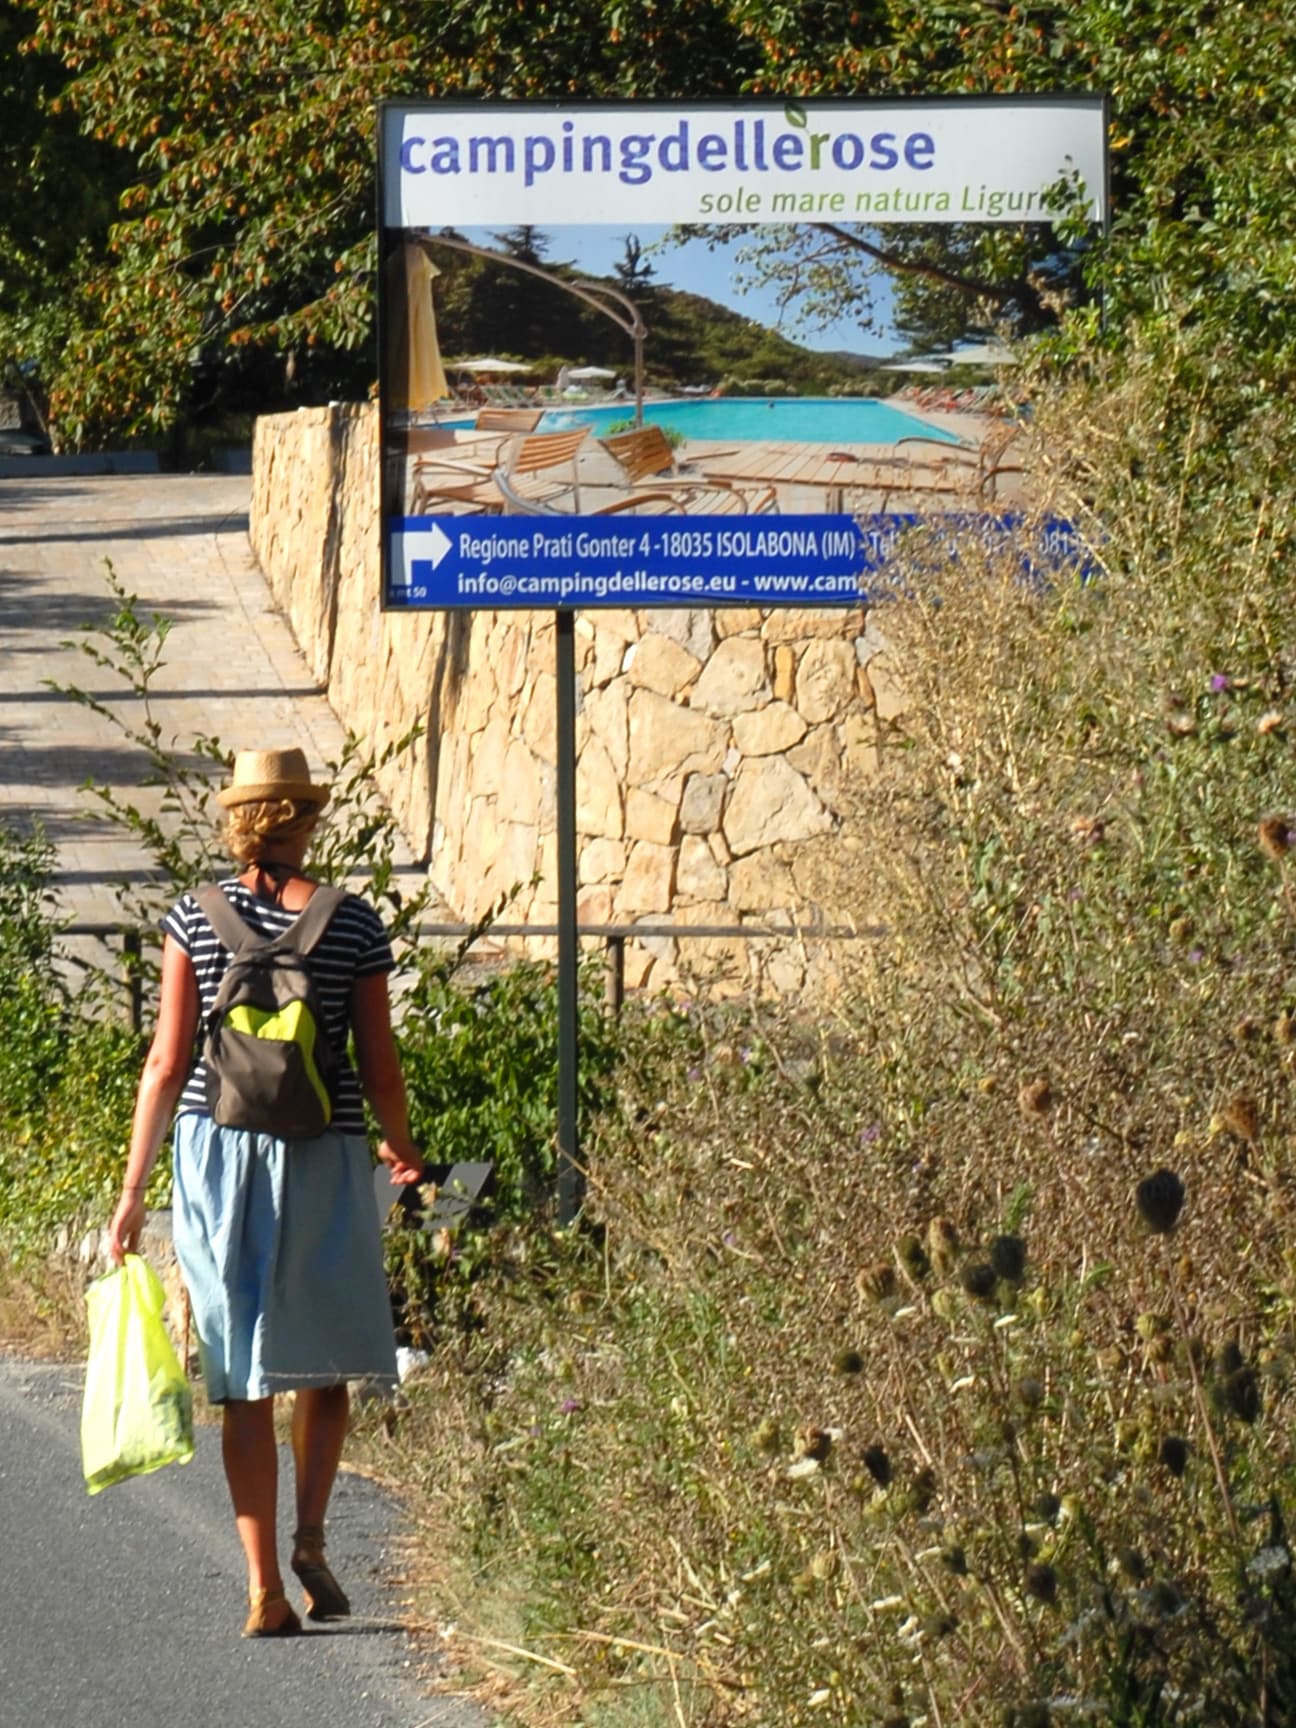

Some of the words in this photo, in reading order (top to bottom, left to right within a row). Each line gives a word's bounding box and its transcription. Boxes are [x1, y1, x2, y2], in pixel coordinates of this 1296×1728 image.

[399, 119, 936, 187] campingdellerose
[699, 186, 761, 213] sole
[771, 190, 846, 213] mare
[855, 187, 951, 213] natura
[459, 532, 530, 565] Regione
[533, 531, 573, 558] Prati
[576, 532, 637, 558] Gonter
[639, 532, 651, 558] 4
[717, 530, 817, 558] ISOLABONA
[822, 530, 856, 560] (IM)
[458, 569, 737, 598] info@campingdellerose.eu
